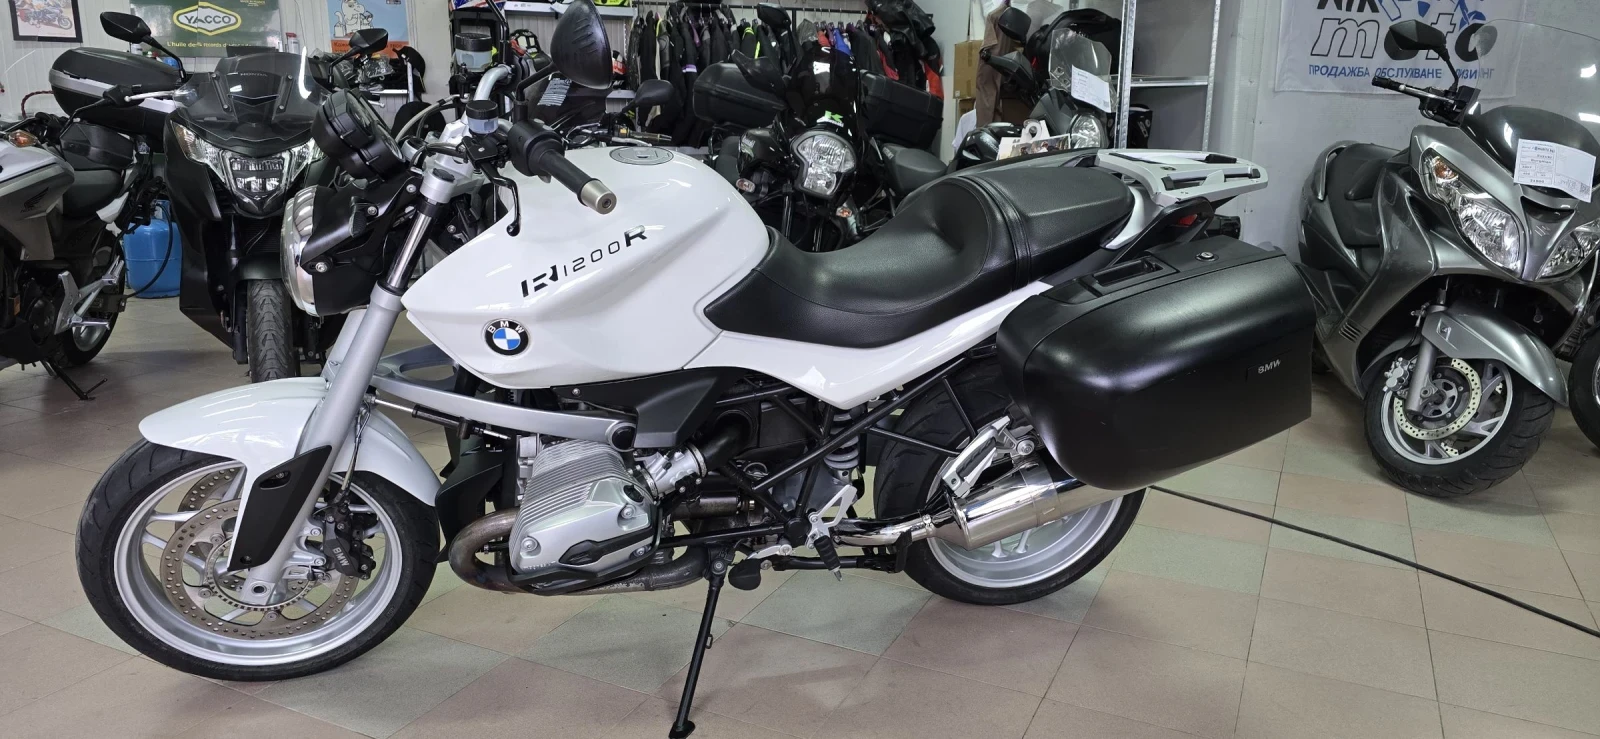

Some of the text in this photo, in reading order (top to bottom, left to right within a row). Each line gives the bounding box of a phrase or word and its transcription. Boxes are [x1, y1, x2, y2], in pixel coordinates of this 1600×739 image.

[184, 15, 231, 24] YACCO
[1309, 64, 1370, 77] ПРОДАЖБА
[487, 320, 525, 334] BMW
[1257, 359, 1281, 375] BMW
[332, 547, 350, 566] BMW
